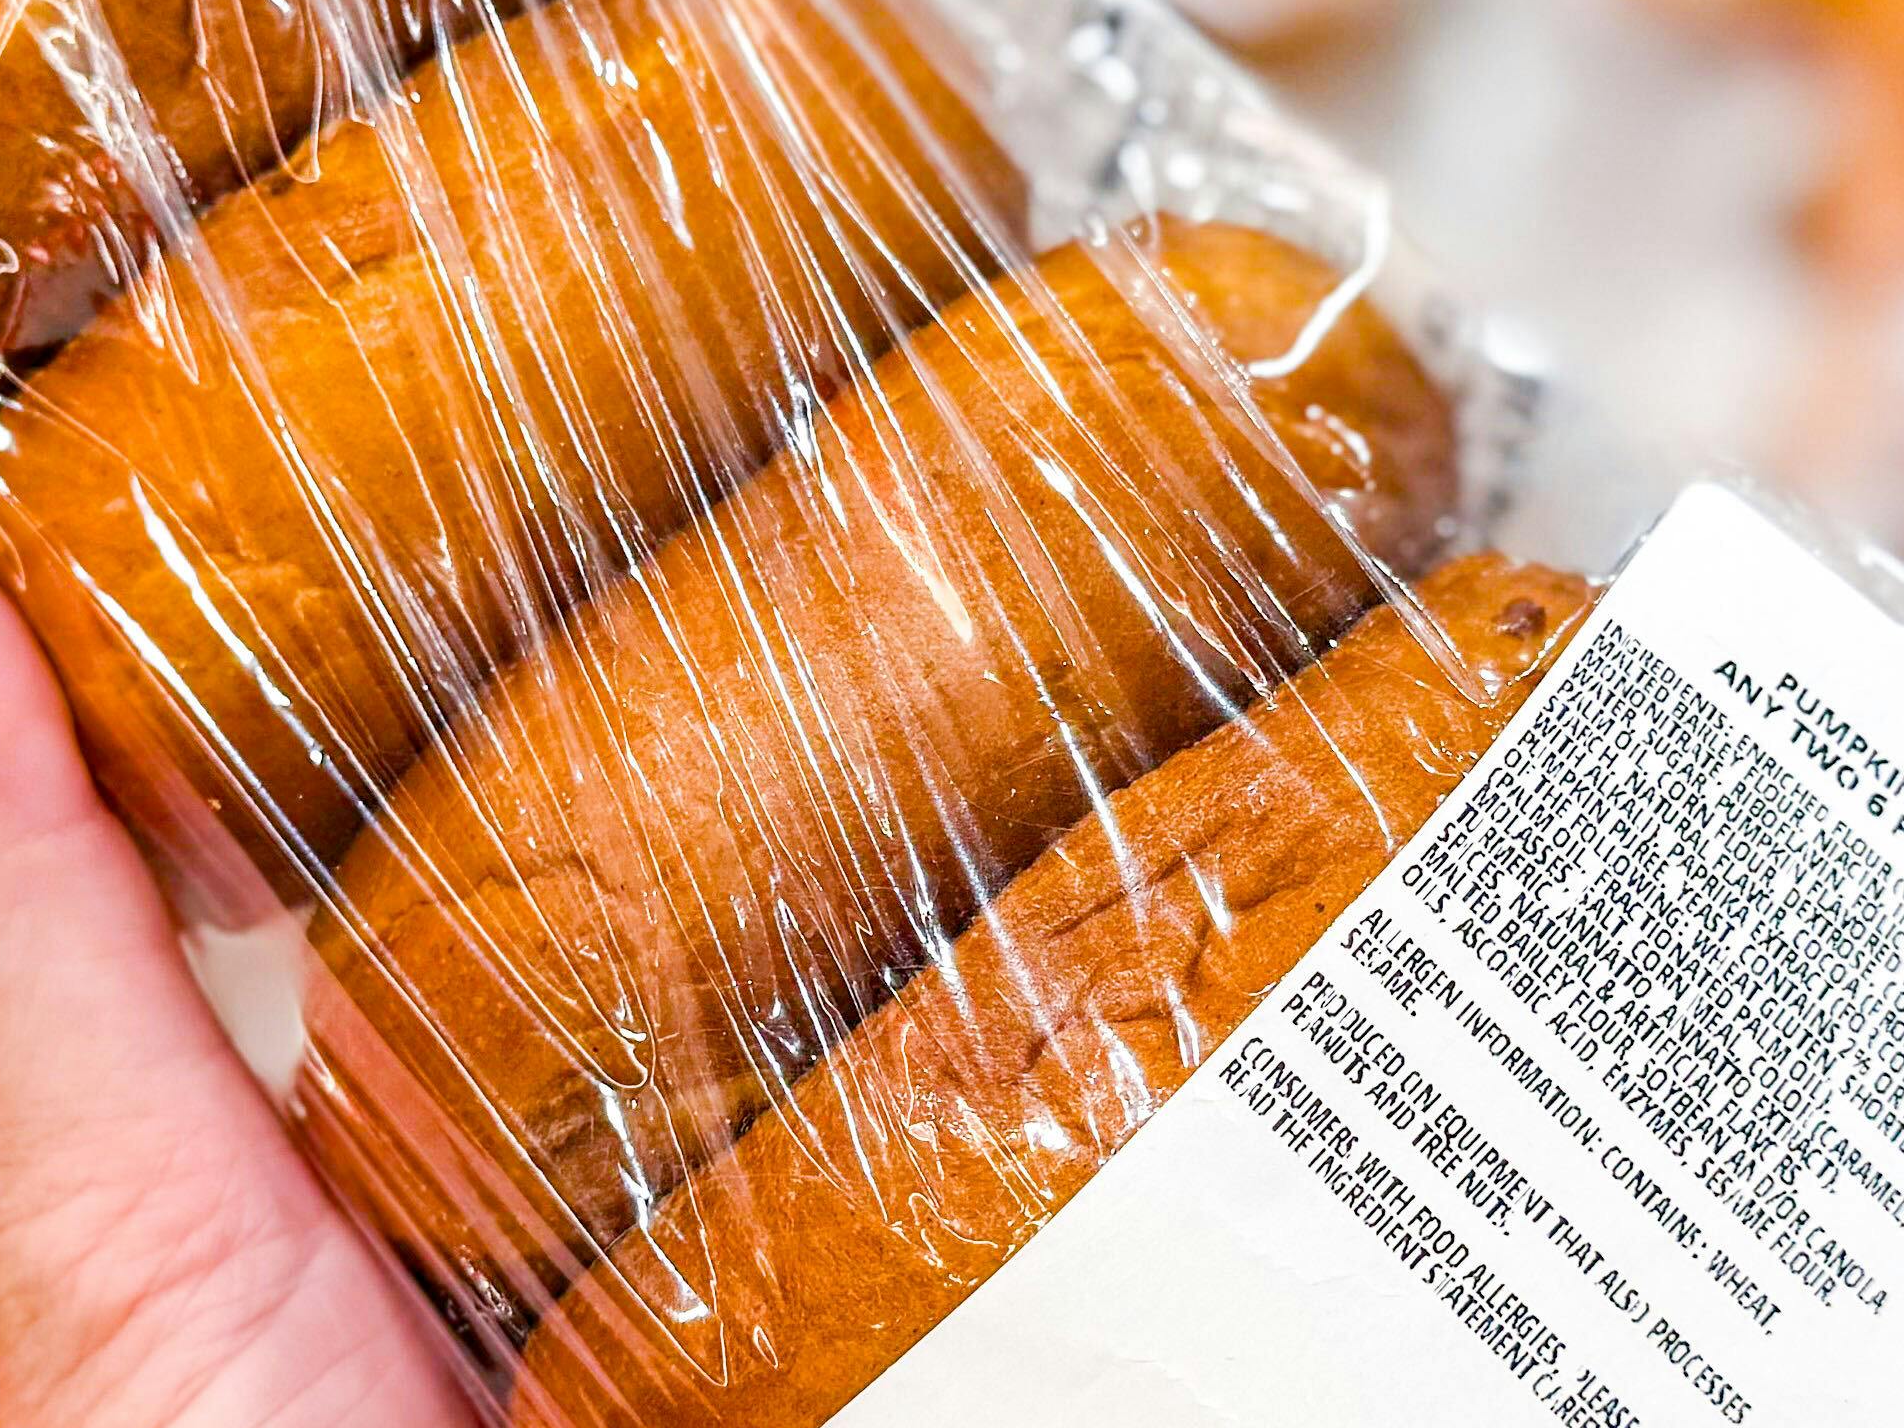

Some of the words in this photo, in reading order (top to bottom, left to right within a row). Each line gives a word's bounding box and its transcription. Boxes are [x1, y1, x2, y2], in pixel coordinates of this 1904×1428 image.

[1555, 677, 1616, 737] PALM
[1655, 769, 1716, 830] CORN
[1590, 631, 1670, 704] MALTED
[1670, 699, 1745, 767] BARLEY
[1601, 617, 1734, 738] INGREDIENTS:
[1734, 732, 1829, 823] ENRICHED
[1830, 818, 1893, 883] FLOUR
[1711, 658, 1785, 719] ANY
[1788, 716, 1860, 791] TWO
[1865, 791, 1889, 818] 6
[1338, 926, 1424, 1018] SESAME.
[1486, 765, 1555, 834] (PALM
[1592, 867, 1734, 1009] FRACTIONATED
[1731, 1003, 1793, 1067] PALM
[1502, 746, 1537, 778] OF
[1532, 774, 1573, 819] THE
[1568, 811, 1690, 937] FOLLOWING:
[1690, 928, 1764, 1003] WHEAT
[1515, 728, 1612, 825] PUMPKIN
[1737, 942, 1841, 1044] CONTAINS
[1531, 709, 1587, 769] WITH
[1664, 840, 1750, 929] PAPRIKA
[1748, 918, 1835, 1002] EXTRACT
[1622, 768, 1710, 862] NATURAL
[1791, 927, 1860, 1000] COCOA
[1630, 937, 1692, 1002] CORN
[1713, 792, 1808, 886] PUMPKIN
[1805, 878, 1902, 973] FLAVORED
[1279, 992, 1372, 1085] PEANUTS
[1362, 1079, 1416, 1131] AND
[1410, 1121, 1463, 1179] TREE
[1358, 907, 1464, 1010] ALLERGEN
[1454, 998, 1603, 1154] INFORMATION:
[1599, 1144, 1708, 1260] CONTAINS:
[1418, 841, 1502, 926] MALTED
[1495, 917, 1576, 996] BARLEY
[1634, 1056, 1732, 1156] SOYBEAN
[1721, 1147, 1811, 1237] AND/OR
[1450, 916, 1552, 1015] ASCORBIC
[1692, 1155, 1776, 1241] SESAME
[1507, 890, 1598, 989] NATURAL
[1594, 977, 1617, 1005] &
[1612, 998, 1719, 1109] ARTIFICIAL
[1654, 1002, 1752, 1099] ANNATTO
[1217, 1057, 1276, 1117] READ
[1270, 1106, 1315, 1157] THE
[1306, 1146, 1431, 1271] INGREDIENT
[1420, 1261, 1540, 1380] STATEMENT
[1239, 1035, 1359, 1160] CONSUMERS
[1353, 1149, 1416, 1216] WITH
[1406, 1204, 1470, 1269] FOOD
[1398, 1069, 1442, 1114] ON
[1432, 1102, 1555, 1224] EQUIPMENT
[1545, 1213, 1606, 1276] THAT
[1645, 1315, 1752, 1425] PROCESSES
